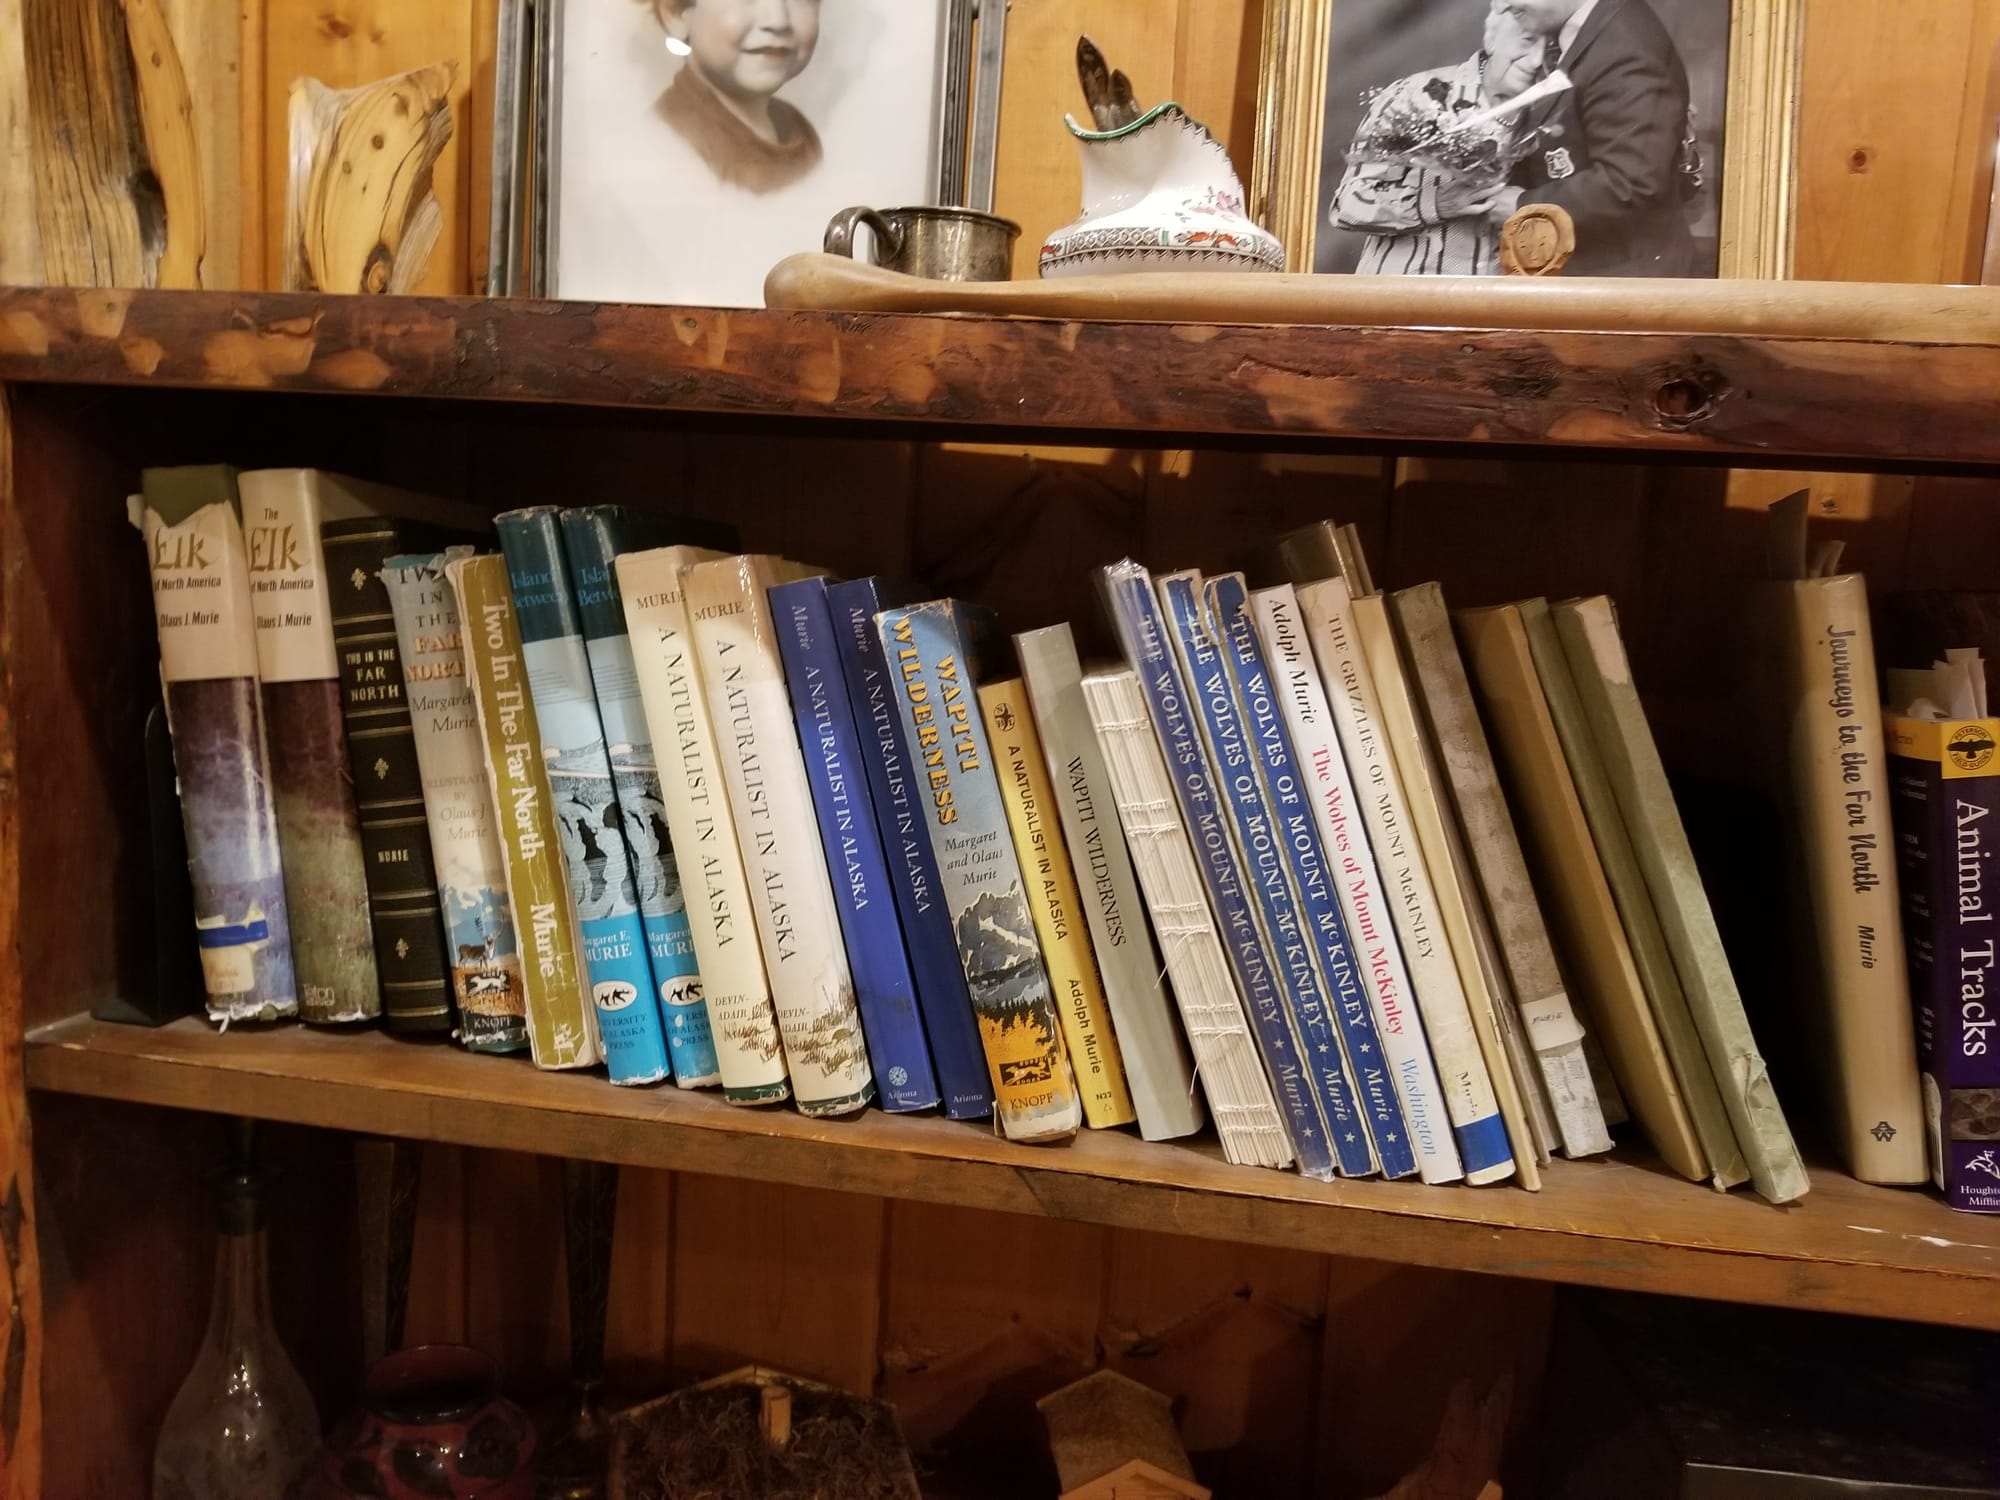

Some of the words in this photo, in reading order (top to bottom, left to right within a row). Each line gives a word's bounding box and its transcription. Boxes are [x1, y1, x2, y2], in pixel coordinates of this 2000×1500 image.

[264, 507, 279, 521] The
[153, 527, 212, 570] Elk
[250, 524, 303, 572] Elk
[161, 578, 184, 592] North
[186, 576, 221, 589] America
[256, 579, 277, 592] North
[279, 577, 314, 591] America
[420, 591, 443, 605] IN
[636, 590, 686, 610] MURIE
[160, 612, 182, 628] Olaus
[191, 609, 220, 625] Murie
[284, 612, 312, 627] Murie
[415, 611, 456, 628] THE
[482, 596, 509, 650] Two
[695, 600, 745, 622] MURIE
[792, 605, 815, 651] Murie
[849, 607, 872, 653] Murie
[1269, 600, 1301, 662] Adolph
[658, 626, 677, 642] A
[716, 639, 737, 656] A
[1328, 613, 1349, 654] THE
[356, 666, 386, 682] FAR
[364, 650, 375, 664] IN
[378, 648, 396, 662] THE
[405, 661, 466, 683] NORT
[491, 652, 517, 682] In
[805, 665, 820, 680] A
[864, 668, 879, 682] A
[1826, 625, 1857, 719] Journeys
[350, 684, 400, 702] NORTH
[496, 682, 524, 737] The
[1290, 669, 1317, 724] Murie
[1341, 660, 1377, 758] GRIZZLIES
[432, 716, 476, 733] Murie
[663, 651, 710, 805] NATURALIST
[892, 617, 958, 826] WILDERNESS
[936, 654, 980, 774] WAPITI
[1954, 727, 1988, 741] PETERSON
[722, 664, 770, 819] NATURALIST
[809, 682, 848, 805] NATURALIST
[868, 684, 908, 808] NATURALIST
[1008, 745, 1021, 757] A
[1837, 725, 1862, 746] to
[504, 742, 532, 781] Far
[1312, 744, 1331, 781] The
[1369, 764, 1386, 788] OF
[1840, 752, 1868, 785] the
[512, 785, 545, 860] North
[836, 808, 854, 832] IN
[896, 811, 914, 834] IN
[1012, 759, 1046, 852] NATURALIST
[1324, 786, 1351, 852] Wolves
[1845, 790, 1872, 828] Far
[695, 817, 716, 842] IN
[755, 829, 777, 856] IN
[944, 831, 998, 852] Margaret
[1377, 793, 1406, 860] MOUNT
[378, 849, 409, 863] MURIE
[946, 853, 969, 870] and
[971, 848, 1003, 864] Olaus
[1038, 858, 1052, 875] IN
[1067, 756, 1096, 823] WAPITI
[1085, 826, 1127, 947] WILDERNESS
[1139, 614, 1164, 663] THE
[1155, 671, 1196, 765] WOLVES
[1186, 773, 1208, 802] OF
[1198, 812, 1240, 898] MOUNT
[1229, 908, 1281, 1025] McKINLEY
[1279, 1063, 1305, 1116] Murie
[1190, 621, 1216, 665] THE
[1205, 671, 1245, 767] WOLVES
[1235, 775, 1257, 804] OF
[1246, 813, 1288, 902] MOUNT
[1276, 910, 1325, 1028] McKINLEY
[1322, 1066, 1351, 1121] Murie
[1231, 616, 1257, 665] THE
[1247, 671, 1287, 767] WOLVES
[1277, 775, 1299, 805] OF
[1288, 813, 1329, 901] MOUNT
[1317, 910, 1368, 1029] McKINLEY
[1364, 1066, 1393, 1121] Murie
[1342, 857, 1362, 874] of
[1848, 833, 1881, 895] North
[1956, 799, 1994, 925] Animal
[841, 835, 869, 911] ALASKA
[902, 839, 931, 914] ALASKA
[962, 870, 999, 887] Murie
[702, 855, 735, 948] ALASKA
[763, 868, 797, 963] ALASKA
[1043, 880, 1069, 941] ALASKA
[1349, 879, 1380, 943] Mount
[1398, 866, 1435, 959] McKINLEY
[530, 902, 558, 978] Murie
[620, 930, 631, 942] E.
[1858, 924, 1878, 970] Murie
[1069, 979, 1092, 1029] Adolph
[1367, 947, 1404, 1036] McKinley
[1961, 938, 1997, 1057] Tracks
[1083, 1034, 1102, 1074] Murie
[1009, 1093, 1053, 1110] KNOPF
[1400, 1058, 1436, 1155] Washington
[1960, 1184, 2000, 1196] Hought
